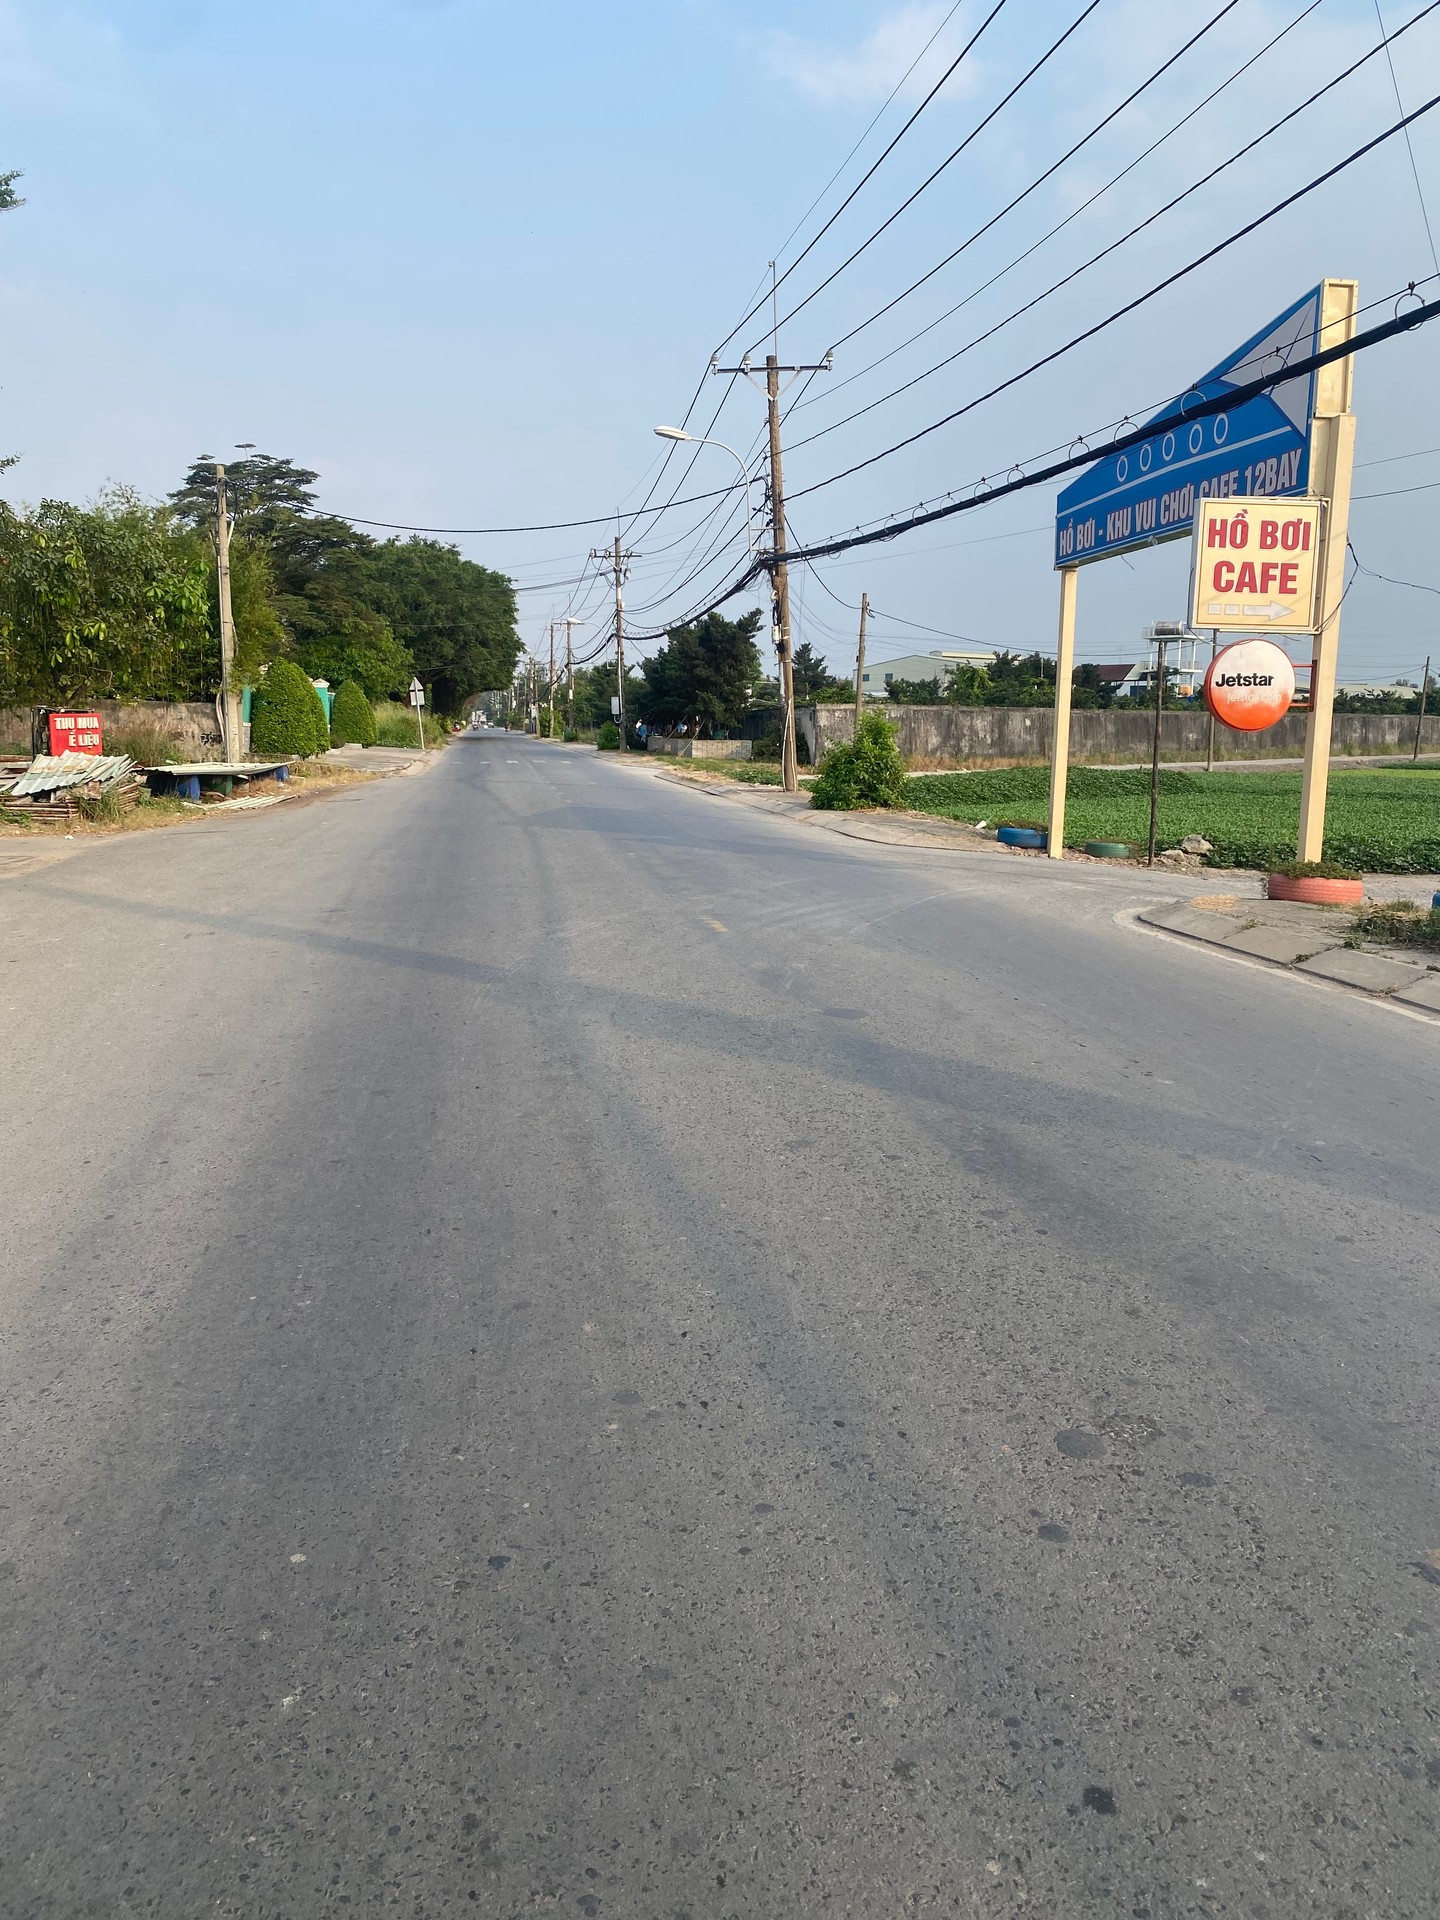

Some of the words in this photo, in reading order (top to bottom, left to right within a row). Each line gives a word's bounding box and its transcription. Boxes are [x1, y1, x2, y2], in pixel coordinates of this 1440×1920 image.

[1059, 518, 1074, 557] HỒ
[1076, 518, 1096, 551] BƠI
[1106, 506, 1132, 542] KHU
[1135, 498, 1157, 533] VUI
[1160, 484, 1195, 526] CHƠI
[1198, 470, 1240, 499] CAFE
[1244, 448, 1303, 497] 12BAY
[1207, 508, 1250, 550] HỒ
[1259, 518, 1312, 552] BƠI
[1212, 560, 1299, 595] CAFE
[1215, 673, 1274, 687] Jetstar
[54, 717, 75, 729] THU
[76, 717, 99, 728] MUA
[78, 731, 99, 748] LIỆU
